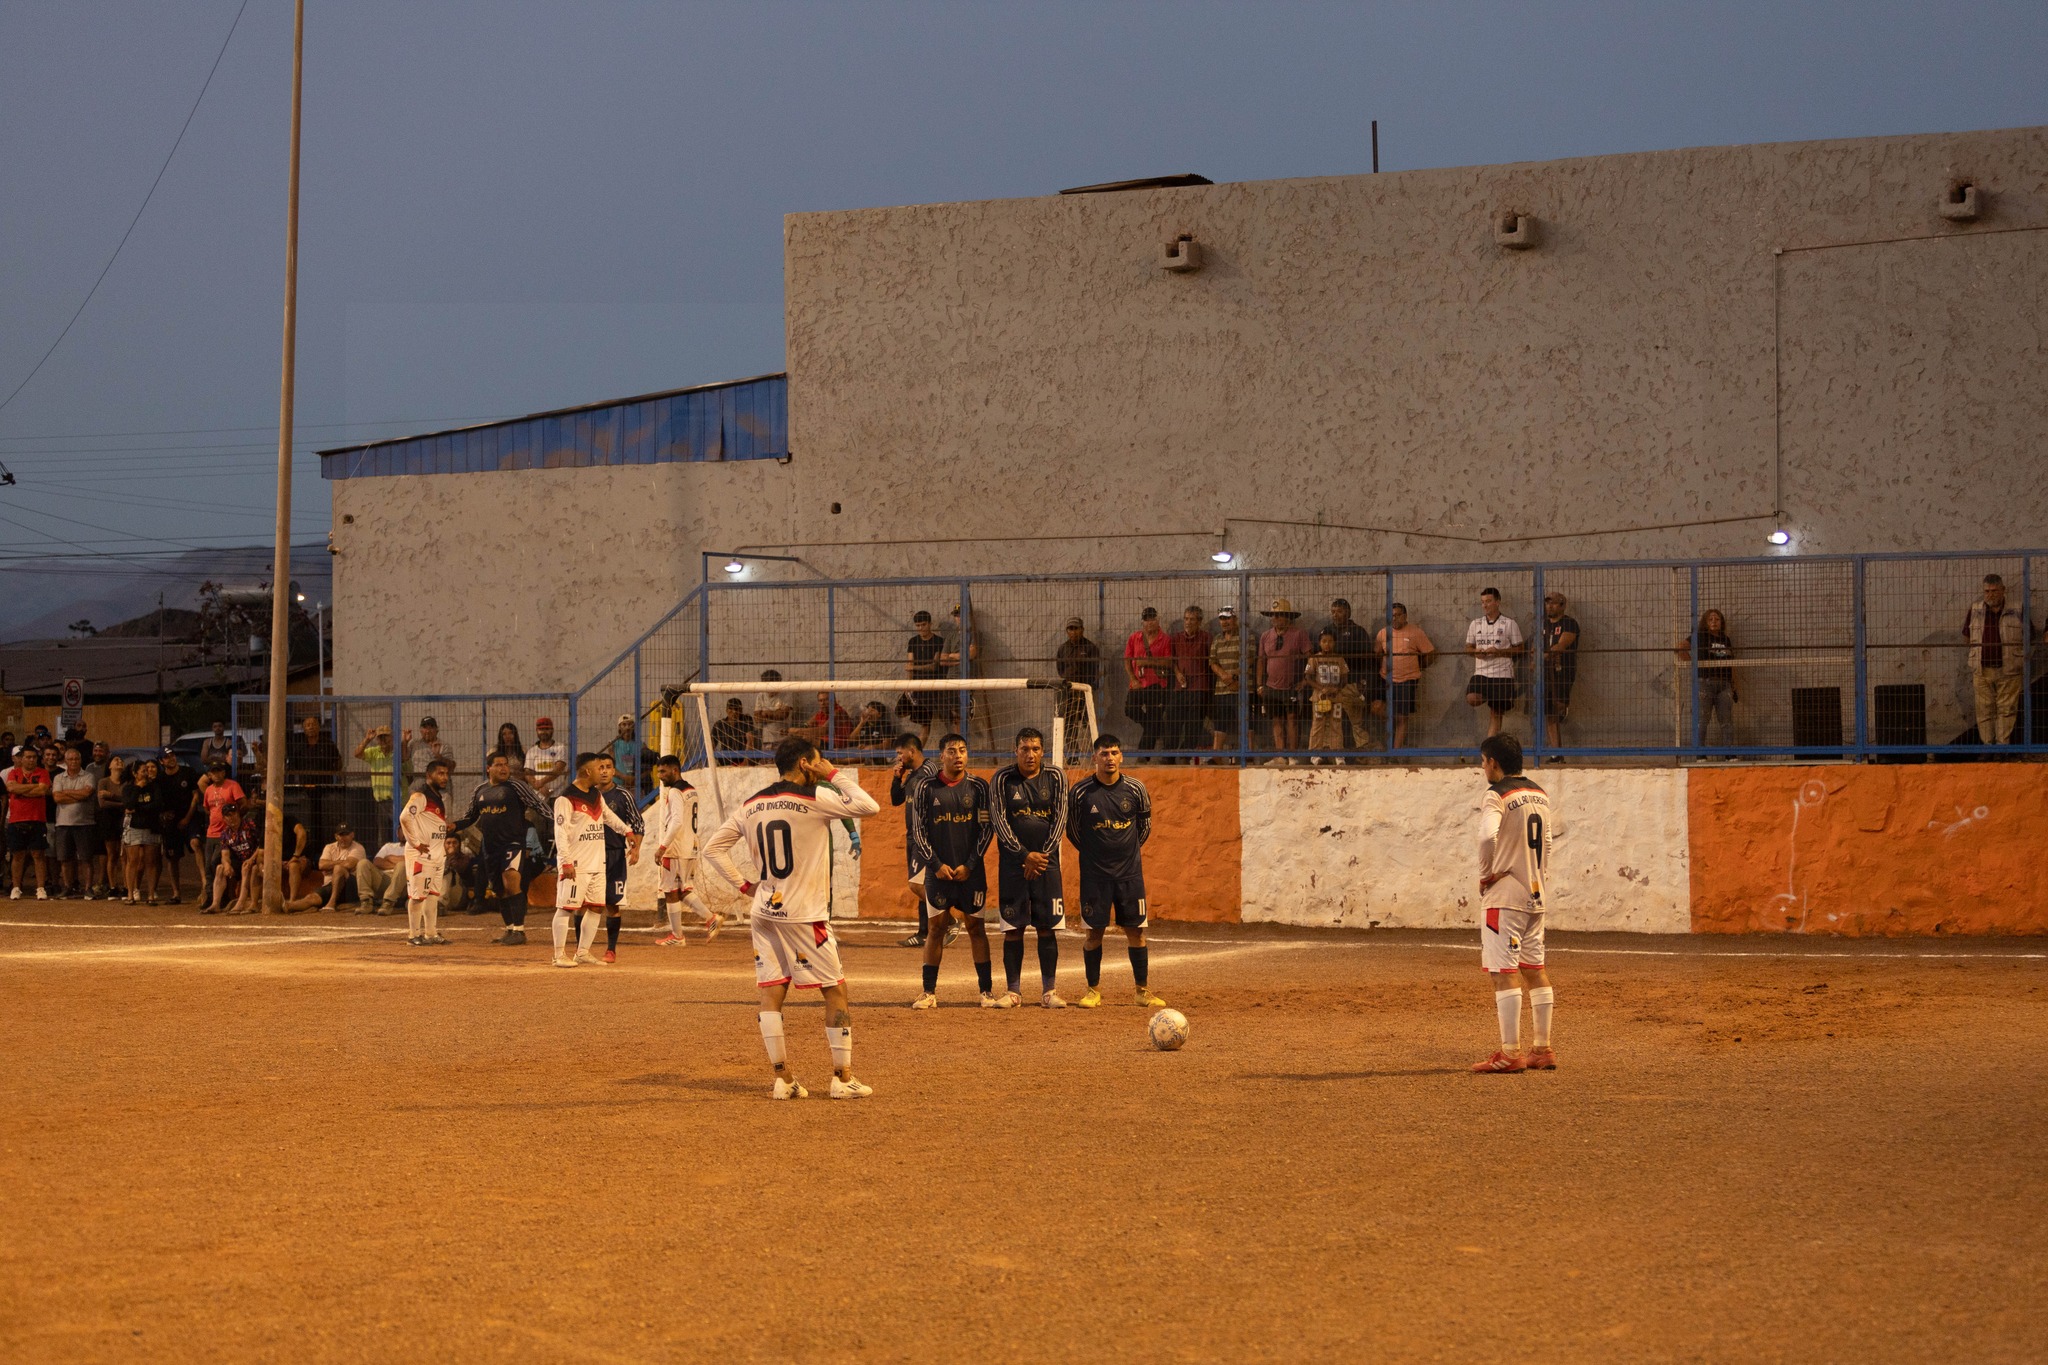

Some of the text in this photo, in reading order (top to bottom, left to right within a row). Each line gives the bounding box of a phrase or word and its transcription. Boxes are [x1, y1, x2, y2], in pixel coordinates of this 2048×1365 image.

[1318, 664, 1341, 684] 98
[691, 802, 699, 835] 8
[745, 800, 809, 819] COLLAO INVERSIONES
[756, 819, 794, 881] 10
[1527, 813, 1543, 870] 9
[911, 858, 919, 873] 4
[570, 884, 578, 899] 11
[615, 881, 624, 895] 12
[973, 890, 985, 907] 10
[1052, 898, 1064, 916] 16
[1137, 898, 1146, 916] 11
